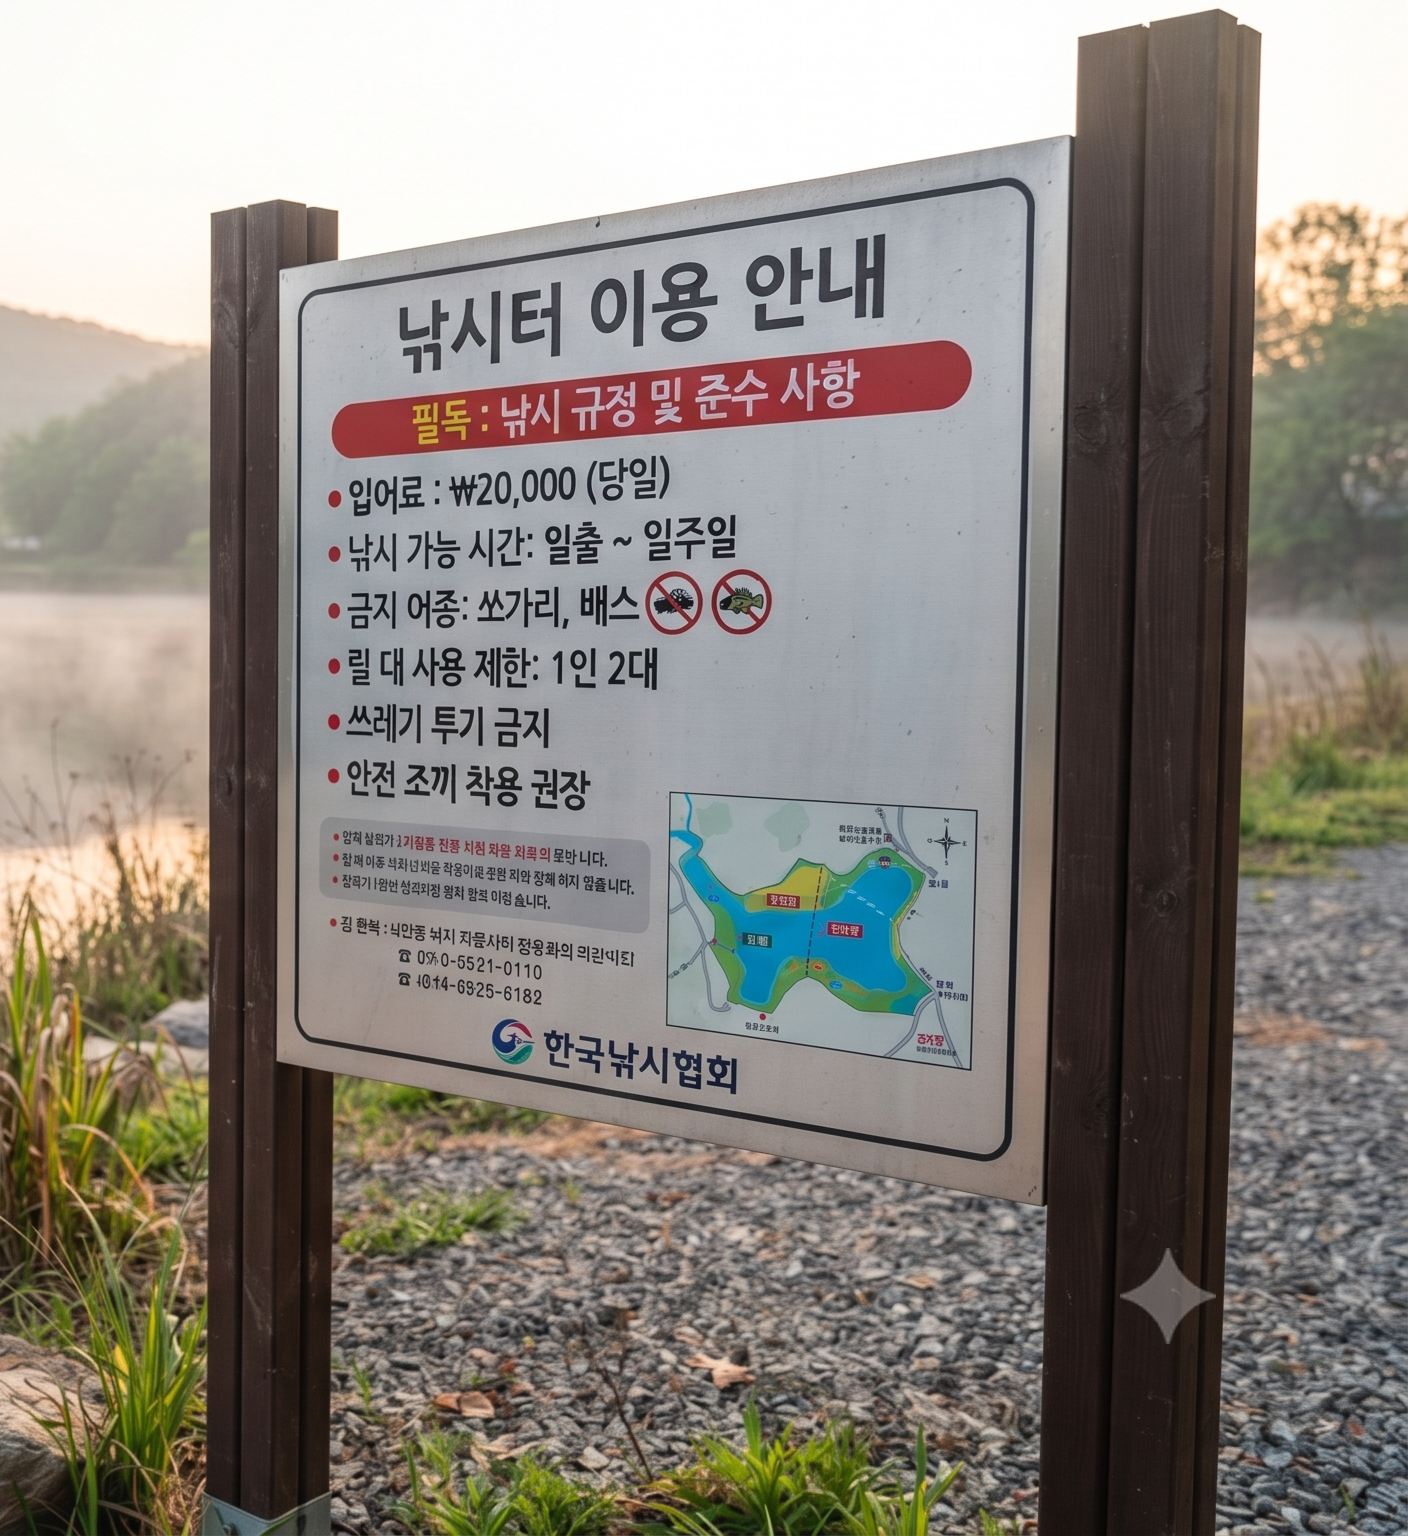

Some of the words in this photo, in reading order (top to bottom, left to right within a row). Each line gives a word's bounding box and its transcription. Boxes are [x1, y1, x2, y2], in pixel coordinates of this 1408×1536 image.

[398, 281, 562, 374] 낚시터
[591, 261, 718, 348] 이용
[745, 233, 886, 332] 안내
[412, 398, 472, 445] 필독
[500, 388, 560, 439] 낚시
[571, 380, 637, 431] 규정
[652, 377, 682, 426] 및
[695, 368, 769, 418] 준수
[780, 358, 860, 411] 사항
[348, 475, 425, 517] 입어료
[448, 466, 577, 509] ₩20,000
[586, 455, 670, 506] (당일)
[349, 533, 397, 573] 낚시
[406, 530, 461, 570] 가능
[468, 526, 533, 568] 시간:
[544, 521, 604, 566] 일출
[643, 514, 736, 562] 일주일
[347, 590, 397, 630] 금지
[407, 589, 468, 629] 어종:
[477, 586, 569, 631] 쏘가리,
[580, 584, 640, 627] 배스
[348, 647, 371, 686] 릴
[380, 647, 404, 687] 대
[411, 647, 466, 687] 사용
[473, 646, 539, 689] 제한:
[552, 647, 597, 689] 1인
[607, 647, 658, 691] 2대
[345, 703, 422, 744] 쓰레기
[431, 706, 484, 747] 투기
[494, 707, 550, 749] 금지
[347, 758, 395, 799] 안전
[403, 763, 456, 804] 조끼
[465, 765, 523, 808] 착용
[530, 768, 591, 811] 권장
[543, 1029, 738, 1095] 한국낚시협회
